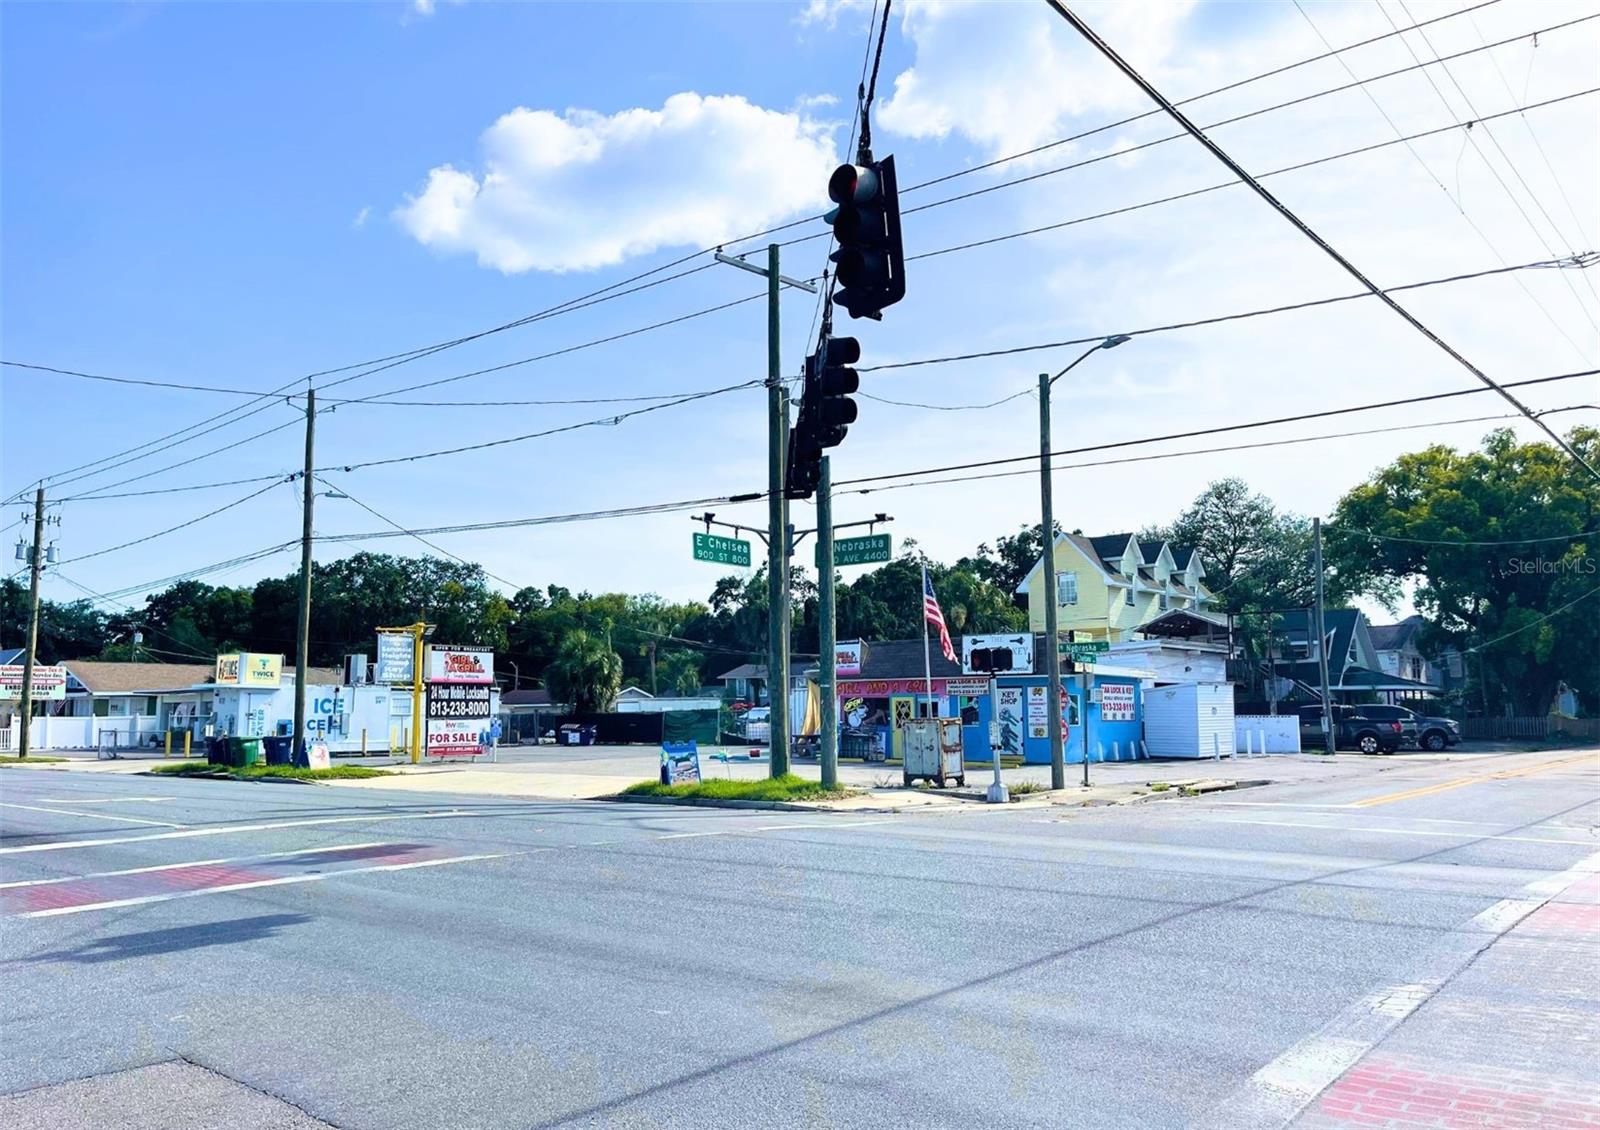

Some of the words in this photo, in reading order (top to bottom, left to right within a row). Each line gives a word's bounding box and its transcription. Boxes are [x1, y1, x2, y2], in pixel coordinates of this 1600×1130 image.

[696, 536, 703, 546] E
[708, 538, 748, 554] Chelsea
[834, 538, 884, 552] Nebraska
[698, 550, 714, 560] 900
[719, 552, 728, 561] ST
[732, 554, 748, 564] 800
[843, 554, 860, 563] AVE
[863, 551, 888, 560] 4400
[450, 654, 473, 664] GIRL
[473, 656, 480, 664] &
[448, 664, 457, 672] A
[457, 663, 485, 673] GRILL
[431, 685, 437, 699] 24
[438, 685, 450, 699] Hour
[450, 685, 465, 699] Mobile
[466, 685, 489, 699] Locksmith
[314, 698, 344, 714] ICE
[430, 701, 489, 715] 813-238-8000
[429, 734, 450, 743] FOR
[452, 733, 477, 742] SALE
